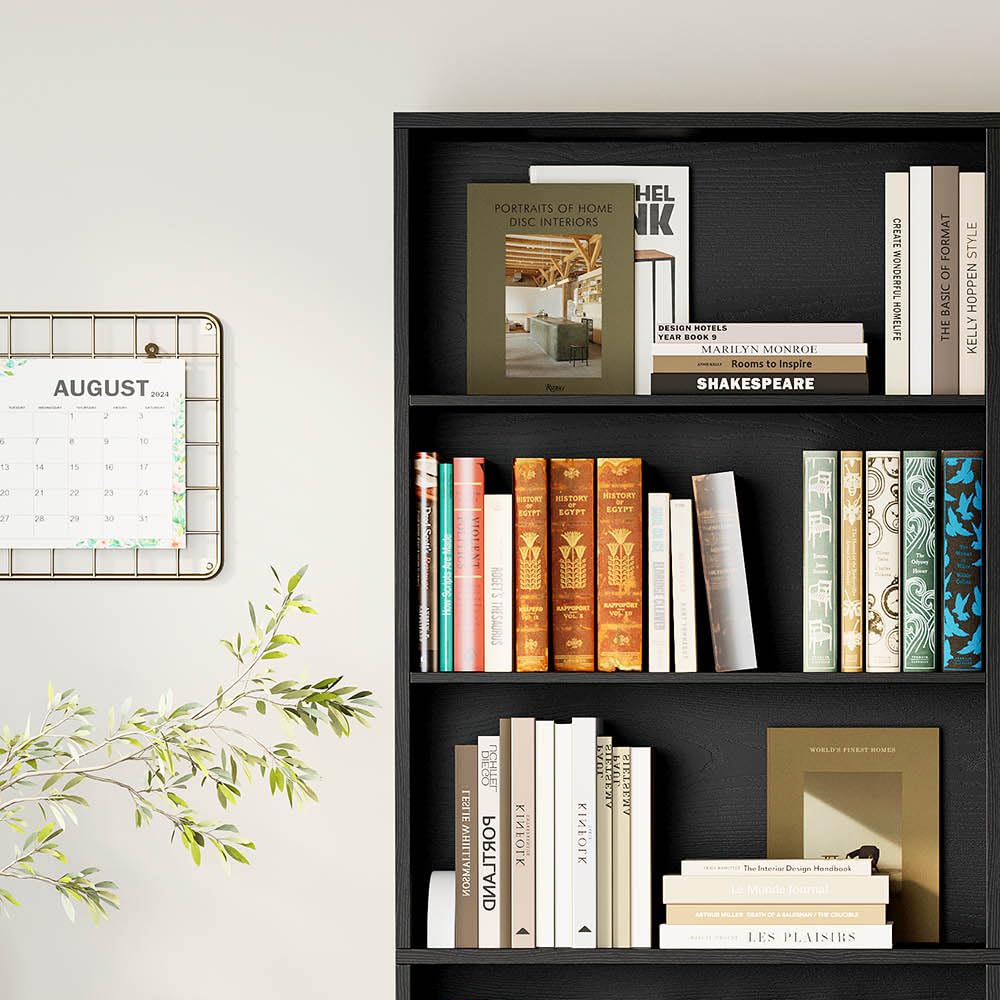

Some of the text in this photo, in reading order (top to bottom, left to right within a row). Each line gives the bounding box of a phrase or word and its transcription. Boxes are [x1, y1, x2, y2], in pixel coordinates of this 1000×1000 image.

[495, 204, 613, 213] PORTRAITS OF HOME
[510, 218, 598, 227] DISC INTERIORS
[893, 218, 901, 341] CREATE WONDERFUL HOMELIFE
[941, 214, 949, 341] THE BASIC OF FORMAT
[967, 222, 977, 354] KELLY HOPPEN STYLE
[702, 345, 817, 353] MARILYN MONROE
[732, 360, 812, 370] Rooms to Inspire
[53, 380, 149, 397] AUGUST
[697, 378, 814, 390] SHAKESPEARE
[492, 602, 503, 645] THESAURUS
[786, 865, 811, 873] Design
[747, 932, 775, 942] LES
[785, 932, 856, 942] PLAISIRS
